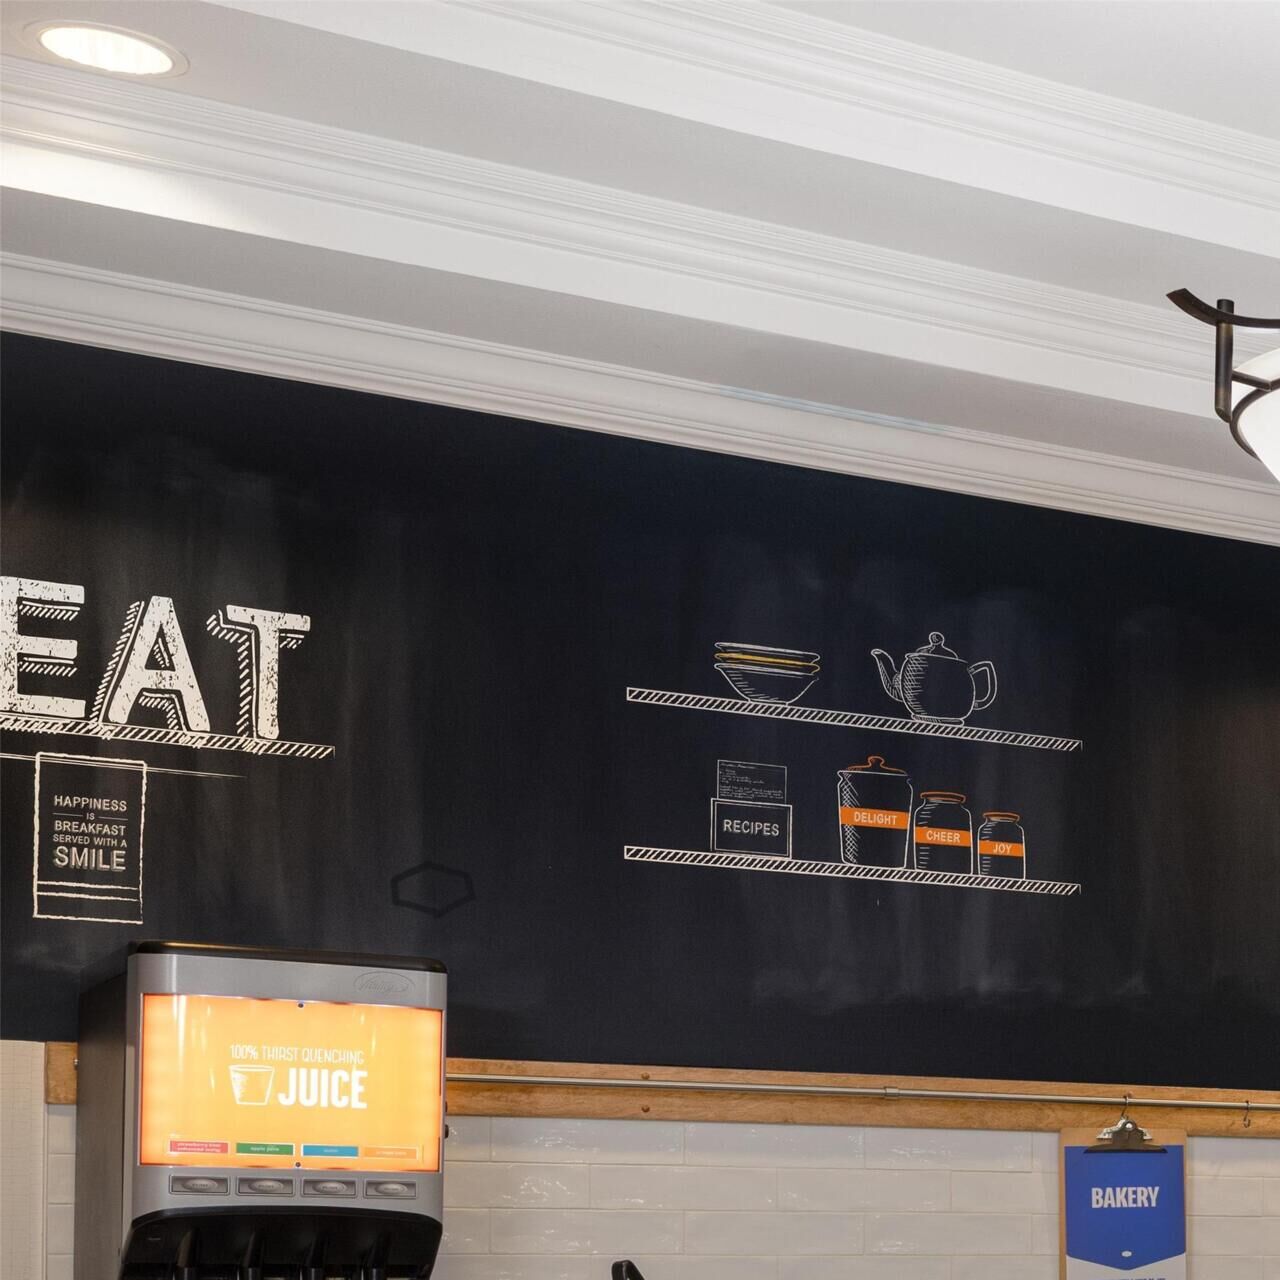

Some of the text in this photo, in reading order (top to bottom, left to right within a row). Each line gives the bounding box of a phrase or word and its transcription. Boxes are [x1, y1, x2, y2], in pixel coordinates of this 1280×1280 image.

[0, 576, 311, 740] EAT
[53, 794, 128, 812] HAPPINESS
[86, 812, 96, 820] IS
[853, 811, 898, 826] DELIGHT
[54, 820, 127, 836] BREAKFAST
[723, 819, 780, 837] RECIPES
[926, 830, 961, 844] CHEER
[53, 833, 128, 848] SERVED WITH A
[992, 843, 1013, 855] JOY
[54, 845, 127, 872] SMILE
[230, 1044, 365, 1064] 100% THIRST QUENCHING
[277, 1067, 369, 1109] JUICE
[1091, 1186, 1160, 1209] BAKERY
